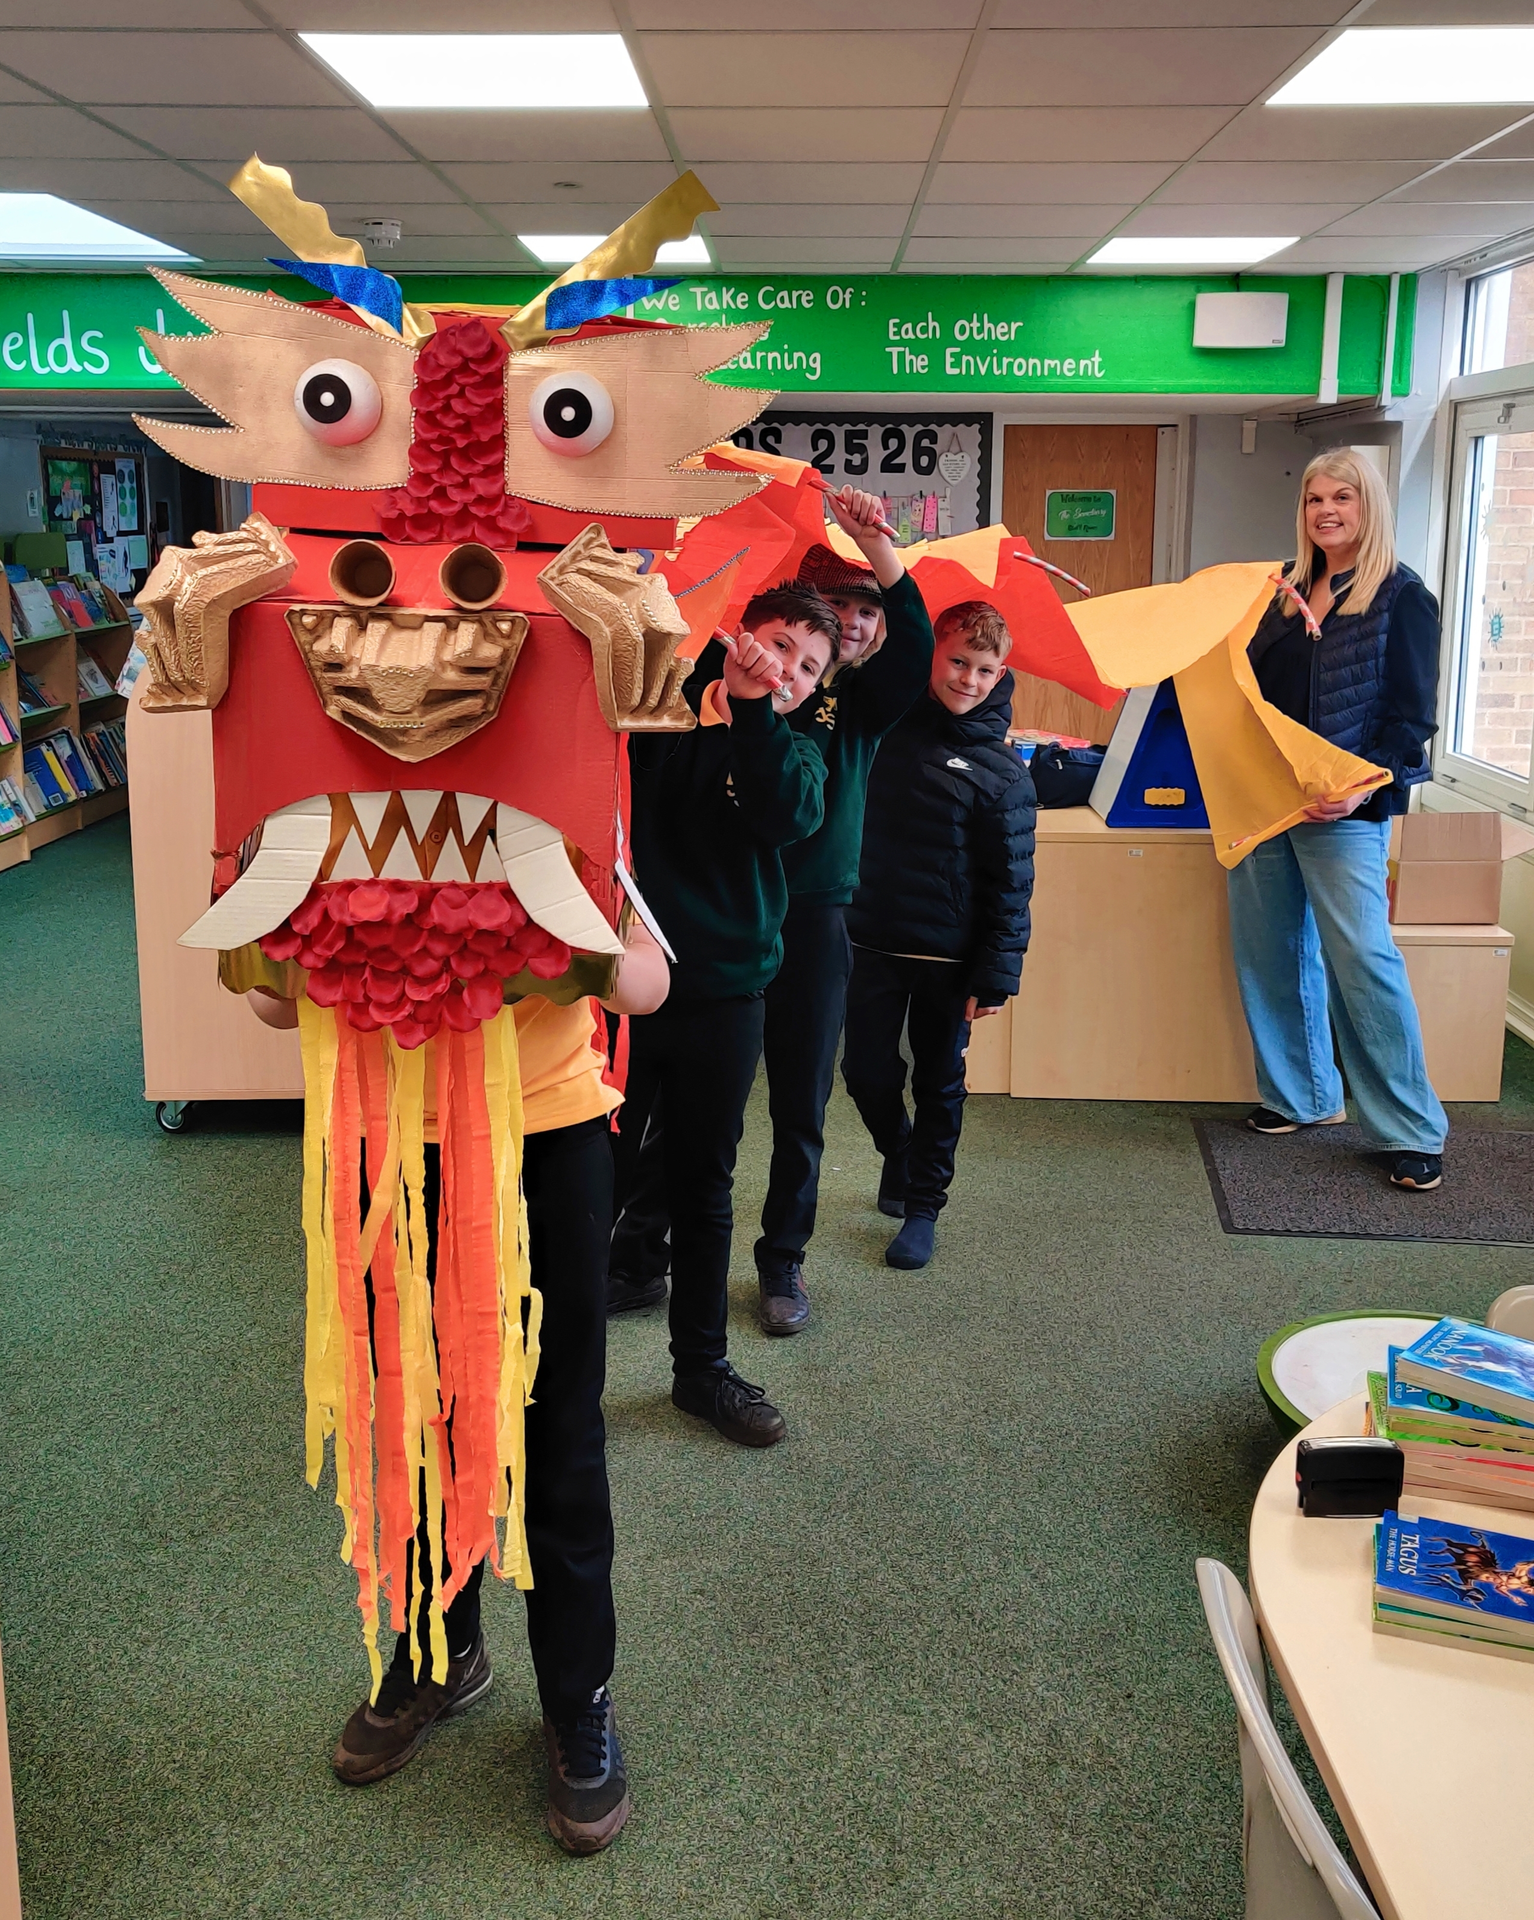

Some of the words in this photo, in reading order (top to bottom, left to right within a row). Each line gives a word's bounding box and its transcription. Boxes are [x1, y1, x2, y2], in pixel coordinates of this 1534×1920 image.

[641, 288, 681, 311] We
[689, 286, 749, 311] Take
[757, 286, 814, 310] Care
[2, 309, 110, 375] elds
[888, 311, 940, 341] Each
[718, 344, 822, 380] earning
[885, 346, 929, 375] The
[945, 347, 1106, 378] Environment
[1422, 1327, 1470, 1362] NANOOK
[1398, 1533, 1420, 1576] TAGUS
